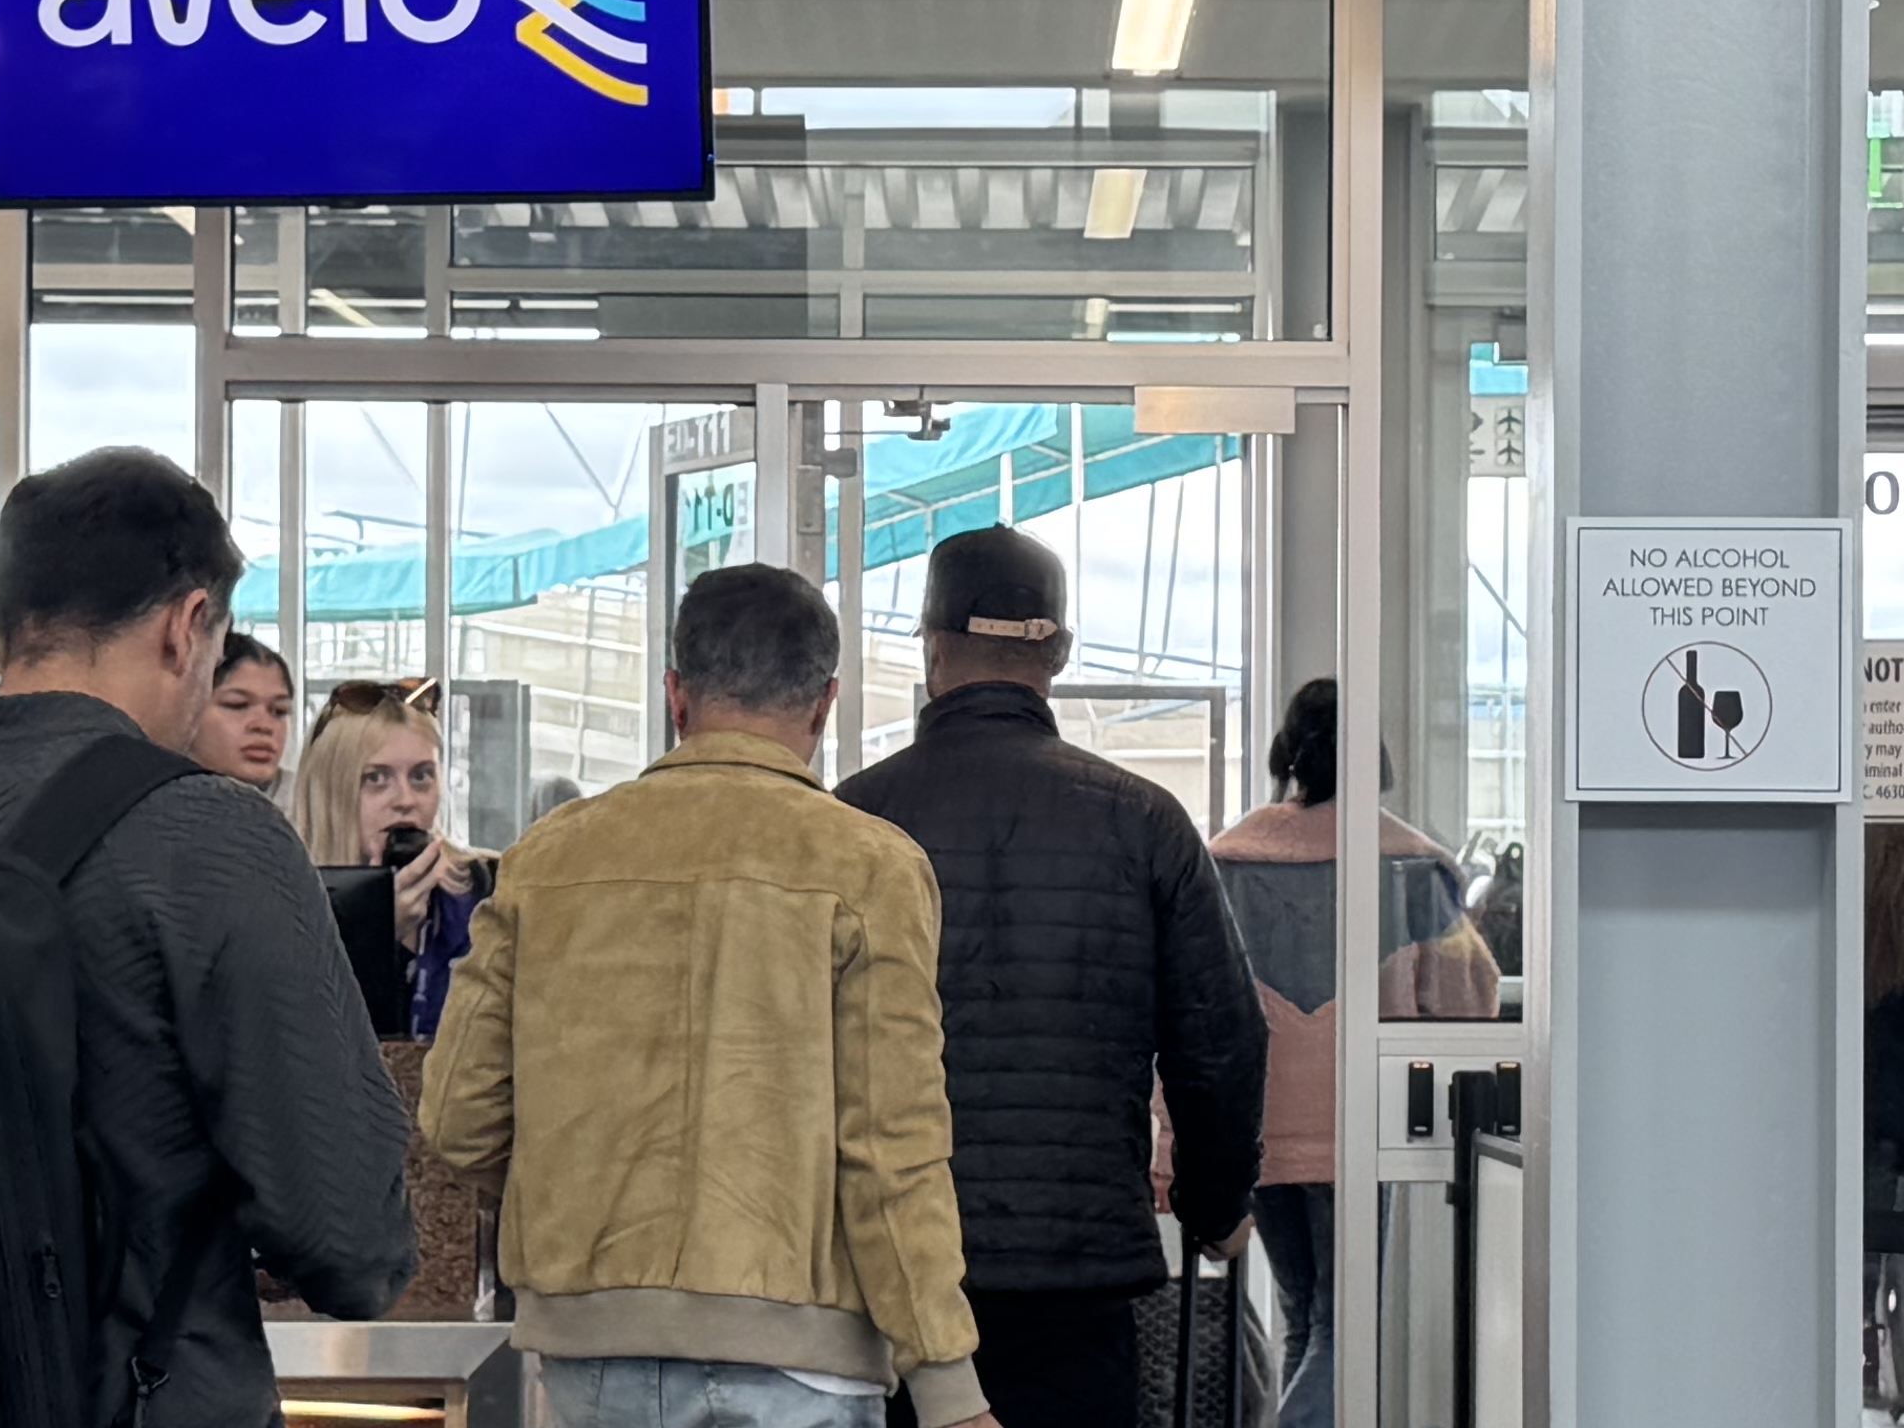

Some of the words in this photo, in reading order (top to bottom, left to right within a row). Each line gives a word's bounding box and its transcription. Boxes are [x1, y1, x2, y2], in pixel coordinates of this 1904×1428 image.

[1629, 548, 1667, 570] NO
[1675, 548, 1790, 570] ALCOHOL
[1602, 577, 1713, 599] ALLOWED
[1722, 578, 1817, 599] BEYOND
[1649, 606, 1693, 627] THIS
[1700, 606, 1769, 627] POINT
[1870, 700, 1902, 714] enter
[1876, 743, 1902, 759] may
